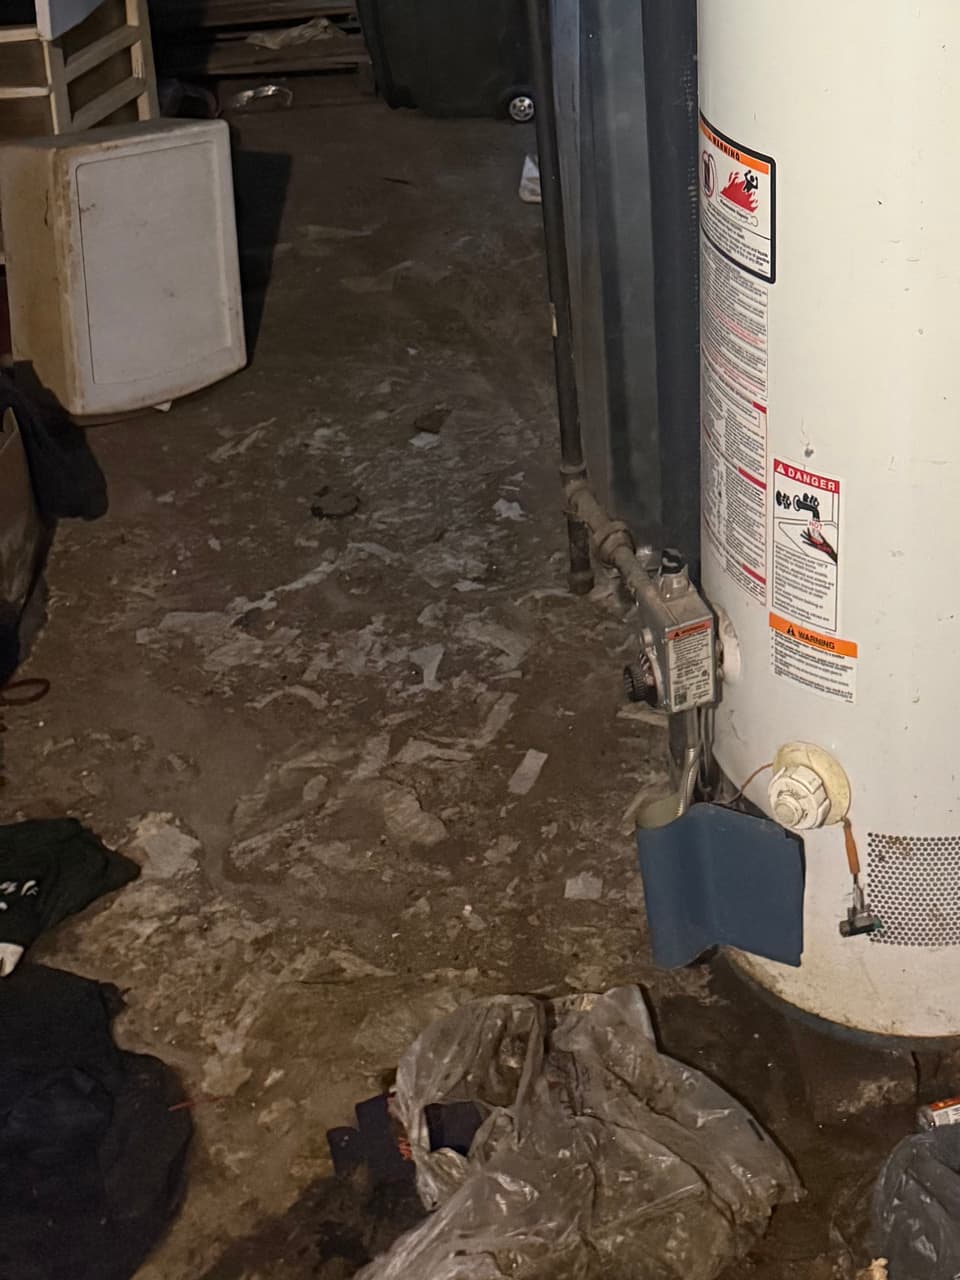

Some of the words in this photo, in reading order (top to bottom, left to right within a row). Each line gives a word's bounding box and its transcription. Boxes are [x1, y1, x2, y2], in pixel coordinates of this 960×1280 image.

[787, 469, 836, 491] DANGER
[808, 520, 823, 530] HOT
[797, 630, 836, 650] WARNING
